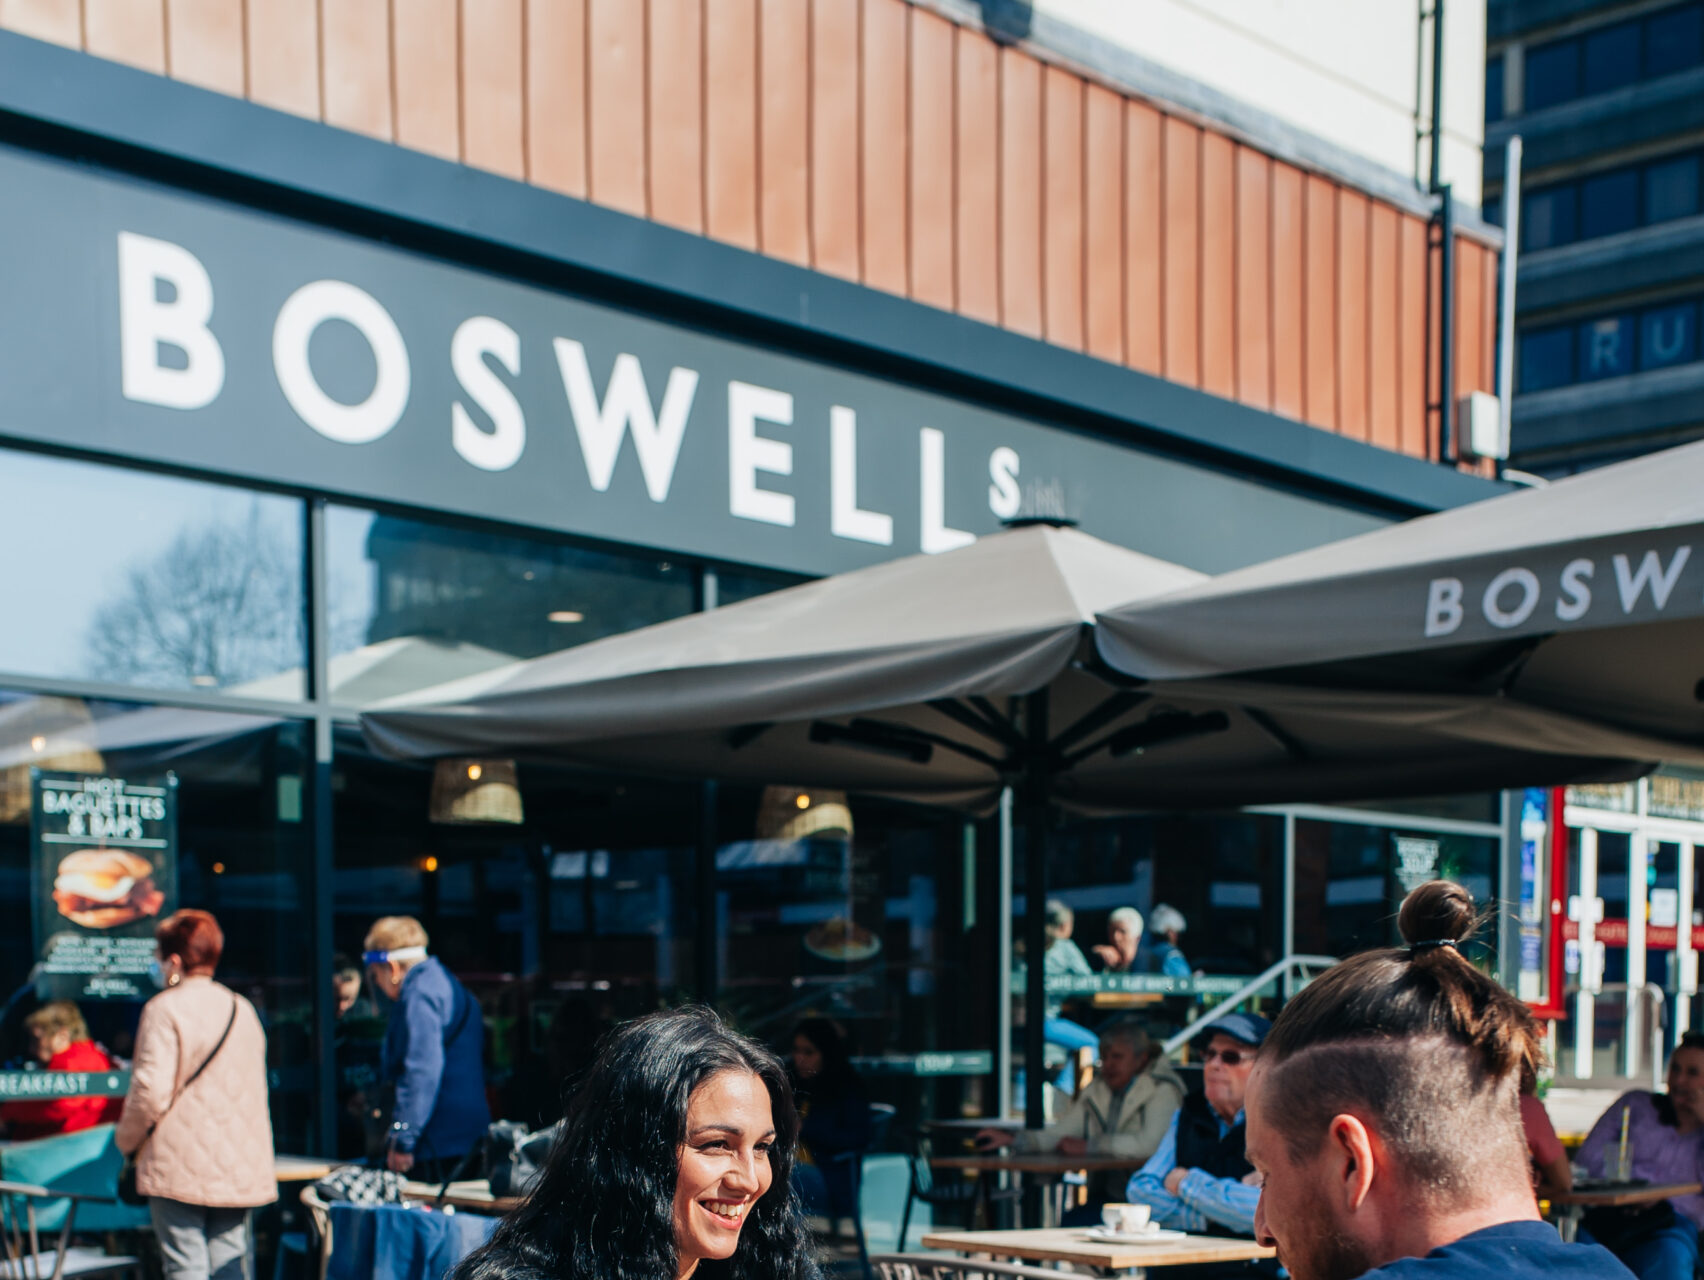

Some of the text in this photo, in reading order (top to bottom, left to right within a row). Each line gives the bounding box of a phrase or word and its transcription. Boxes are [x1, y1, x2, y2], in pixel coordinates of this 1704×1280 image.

[117, 230, 1021, 555] BOSWELLS
[1425, 545, 1704, 637] BOSW
[84, 777, 126, 796] HOT
[42, 790, 166, 820] BAGUETTES
[89, 814, 143, 840] BAPS
